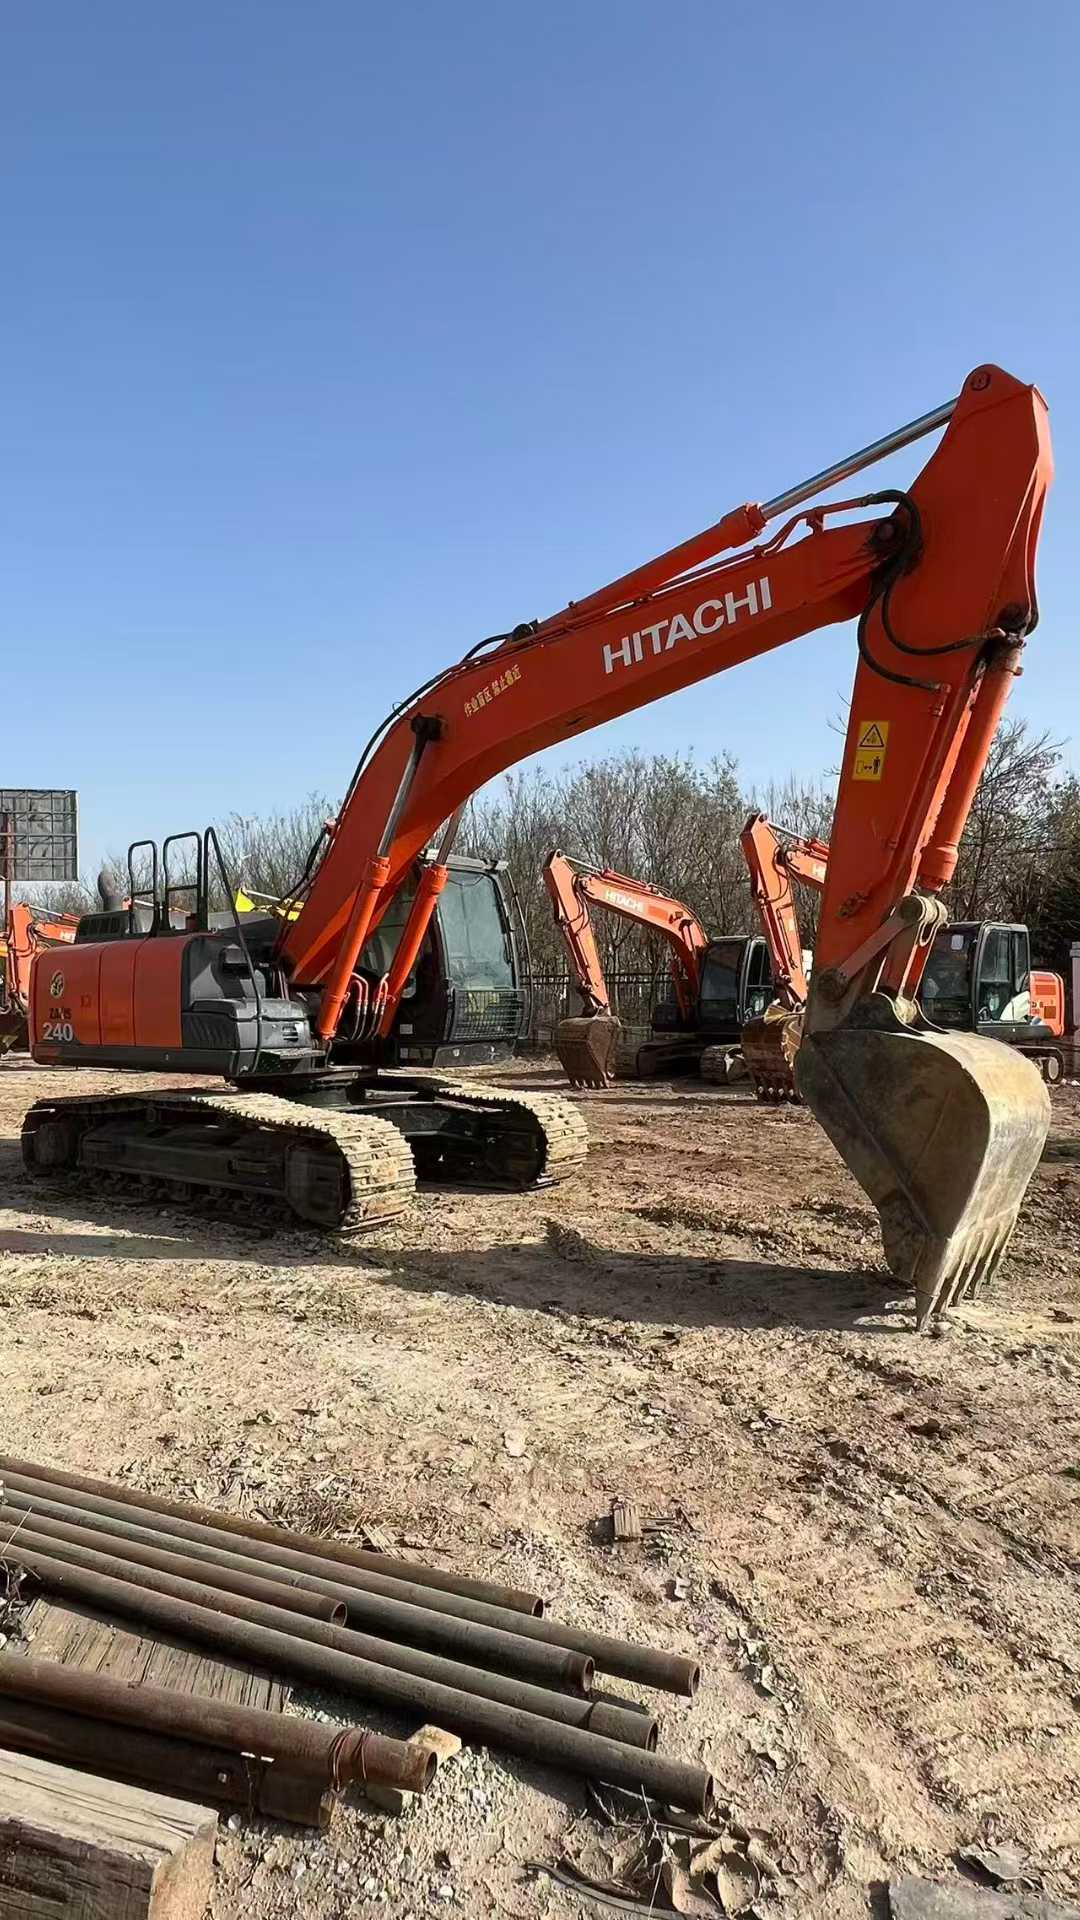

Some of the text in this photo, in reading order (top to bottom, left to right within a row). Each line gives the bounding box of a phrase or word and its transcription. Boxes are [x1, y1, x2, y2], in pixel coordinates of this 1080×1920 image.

[602, 576, 773, 674] HITACHI
[605, 889, 645, 912] HITACHI
[43, 1022, 74, 1041] 240
